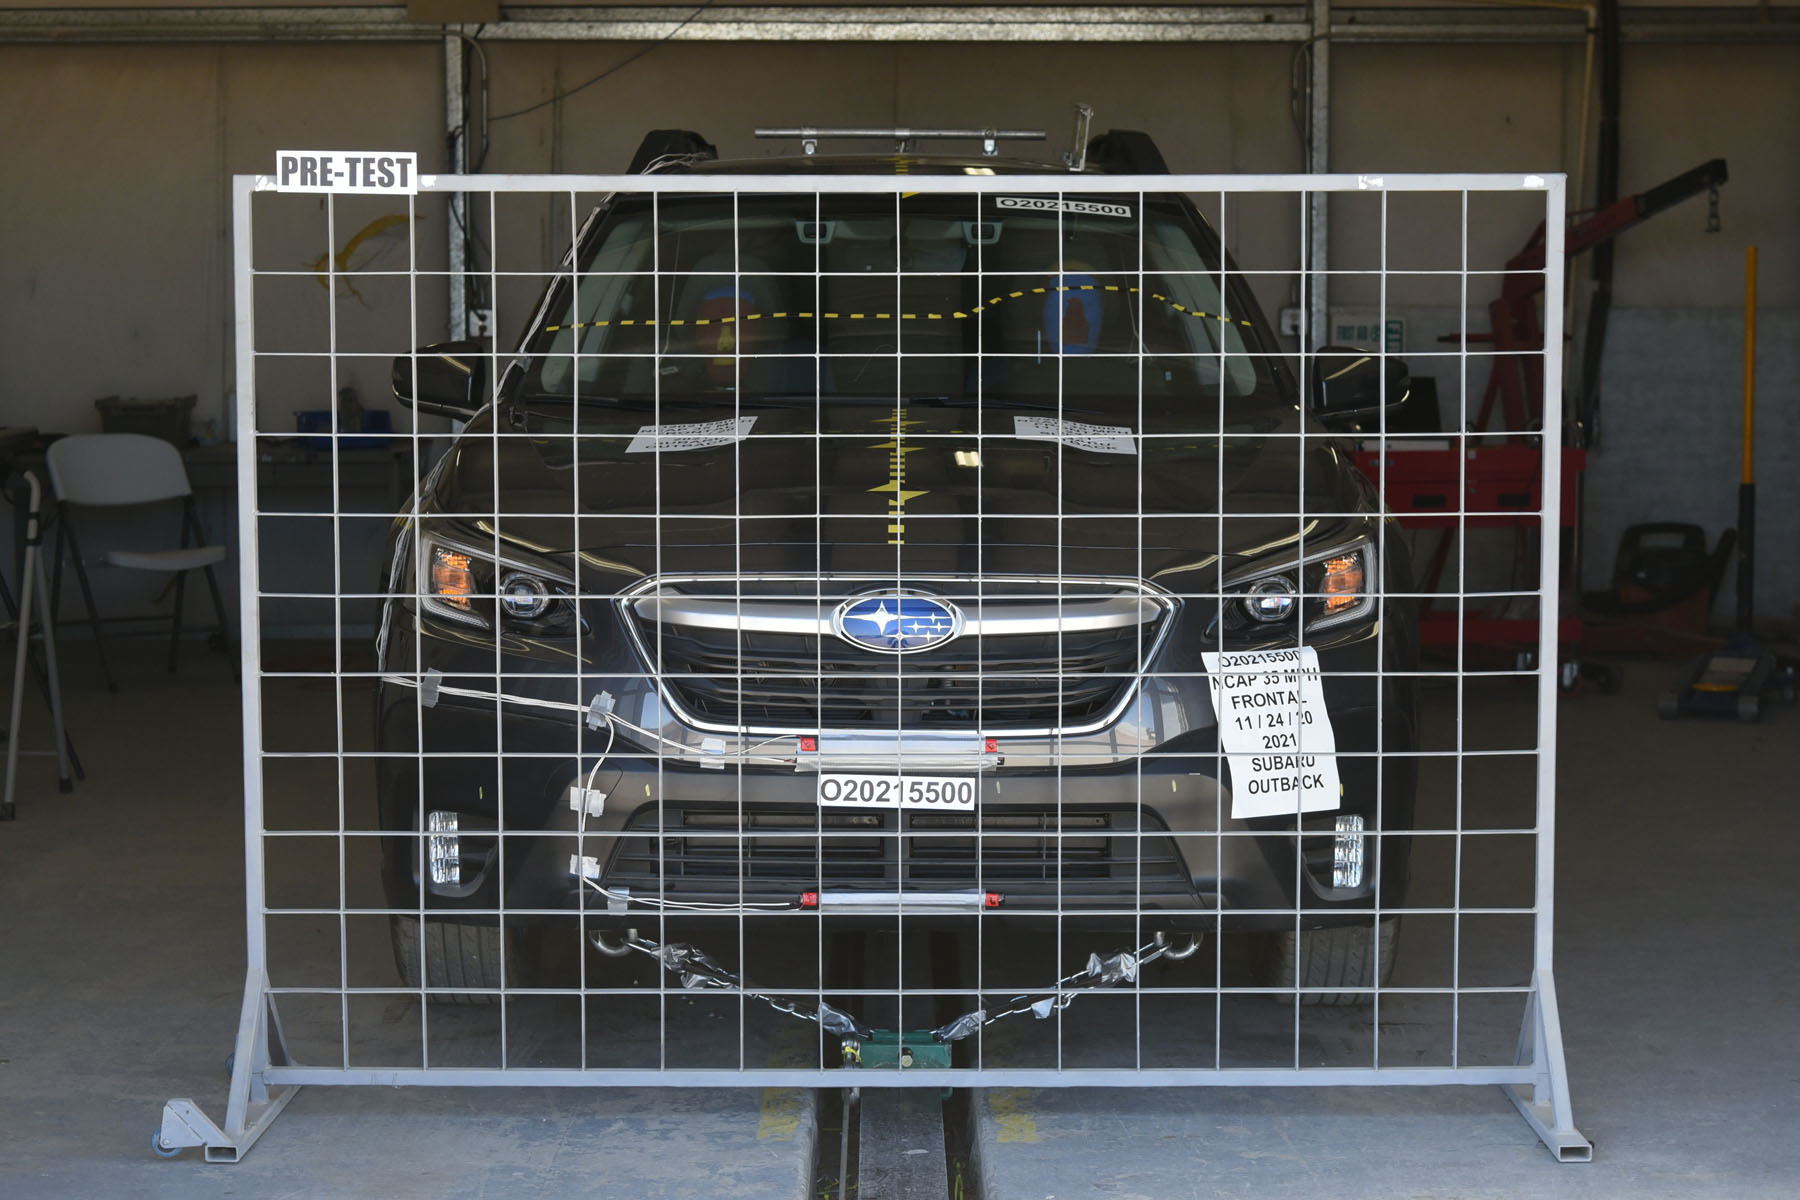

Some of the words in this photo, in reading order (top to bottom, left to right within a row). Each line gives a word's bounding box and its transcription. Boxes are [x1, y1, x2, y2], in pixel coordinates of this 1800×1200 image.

[281, 156, 412, 188] PRE-TEST
[1000, 198, 1127, 215] O20215500
[1212, 673, 1257, 690] NCAP
[1263, 670, 1280, 685] 35
[1235, 716, 1252, 730] 11
[1266, 713, 1284, 728] 24
[1262, 733, 1297, 749] 2021
[1252, 755, 1316, 772] SUBARU
[821, 778, 972, 804] O20215500
[1248, 773, 1325, 794] OUTBACK
